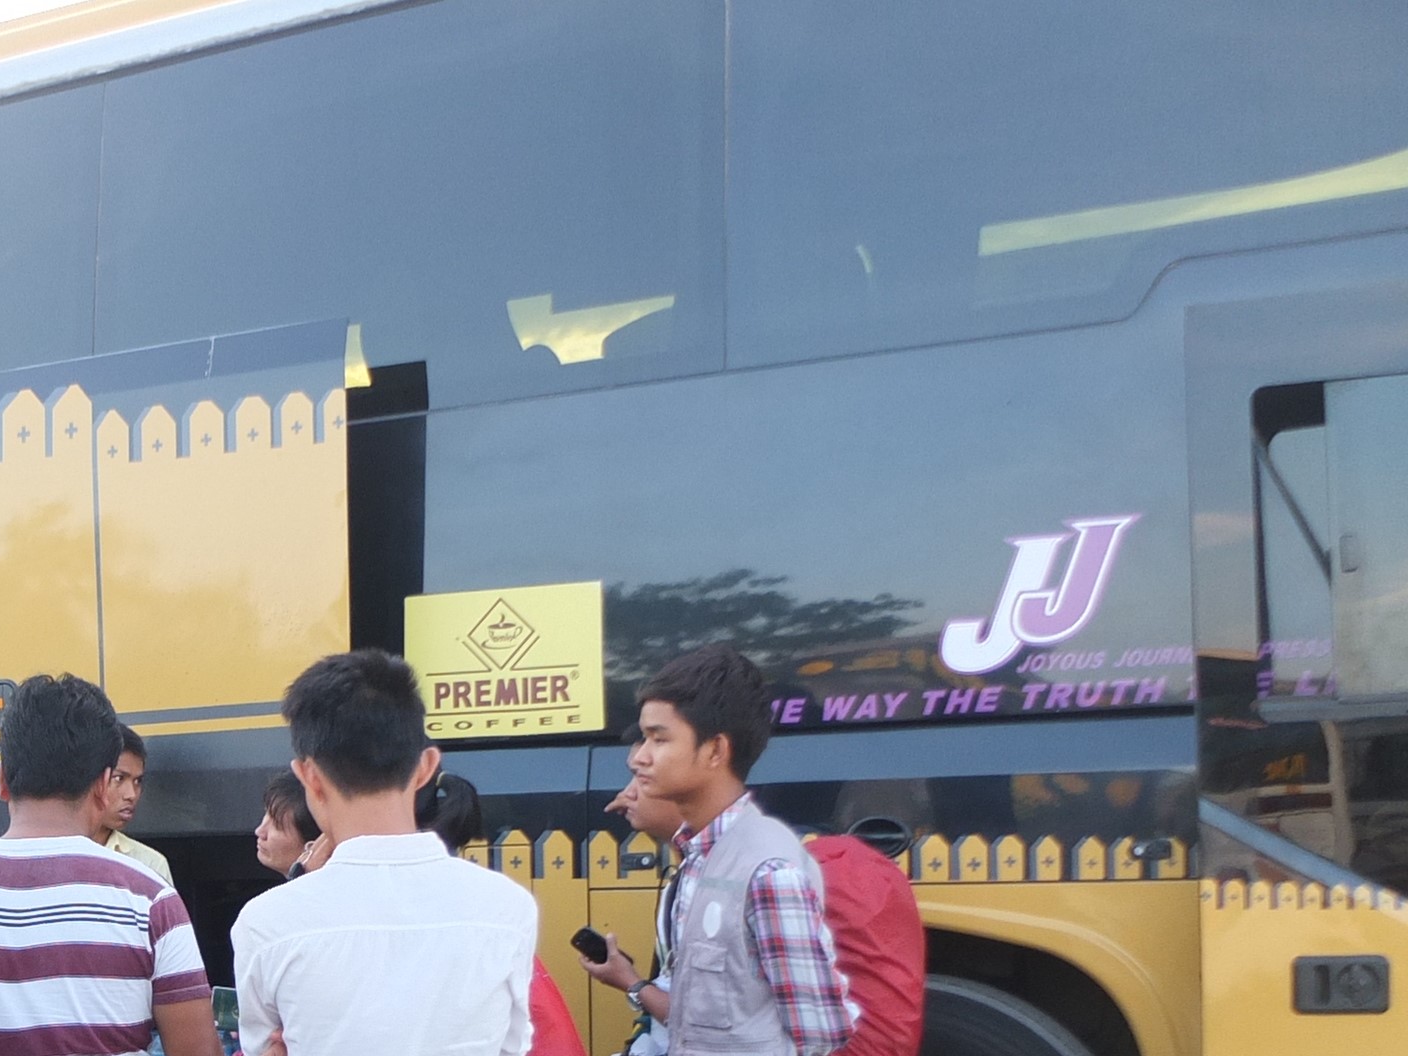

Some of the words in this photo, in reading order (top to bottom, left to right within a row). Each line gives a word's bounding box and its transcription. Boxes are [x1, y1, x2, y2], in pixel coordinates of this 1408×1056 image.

[1016, 650, 1106, 674] JOYOUS
[1113, 644, 1193, 668] JOURN
[434, 674, 571, 710] PREMIER
[821, 690, 909, 722] WAY
[922, 685, 1005, 716] THE
[1021, 675, 1168, 711] TRUTH
[426, 714, 581, 732] COFFEE
